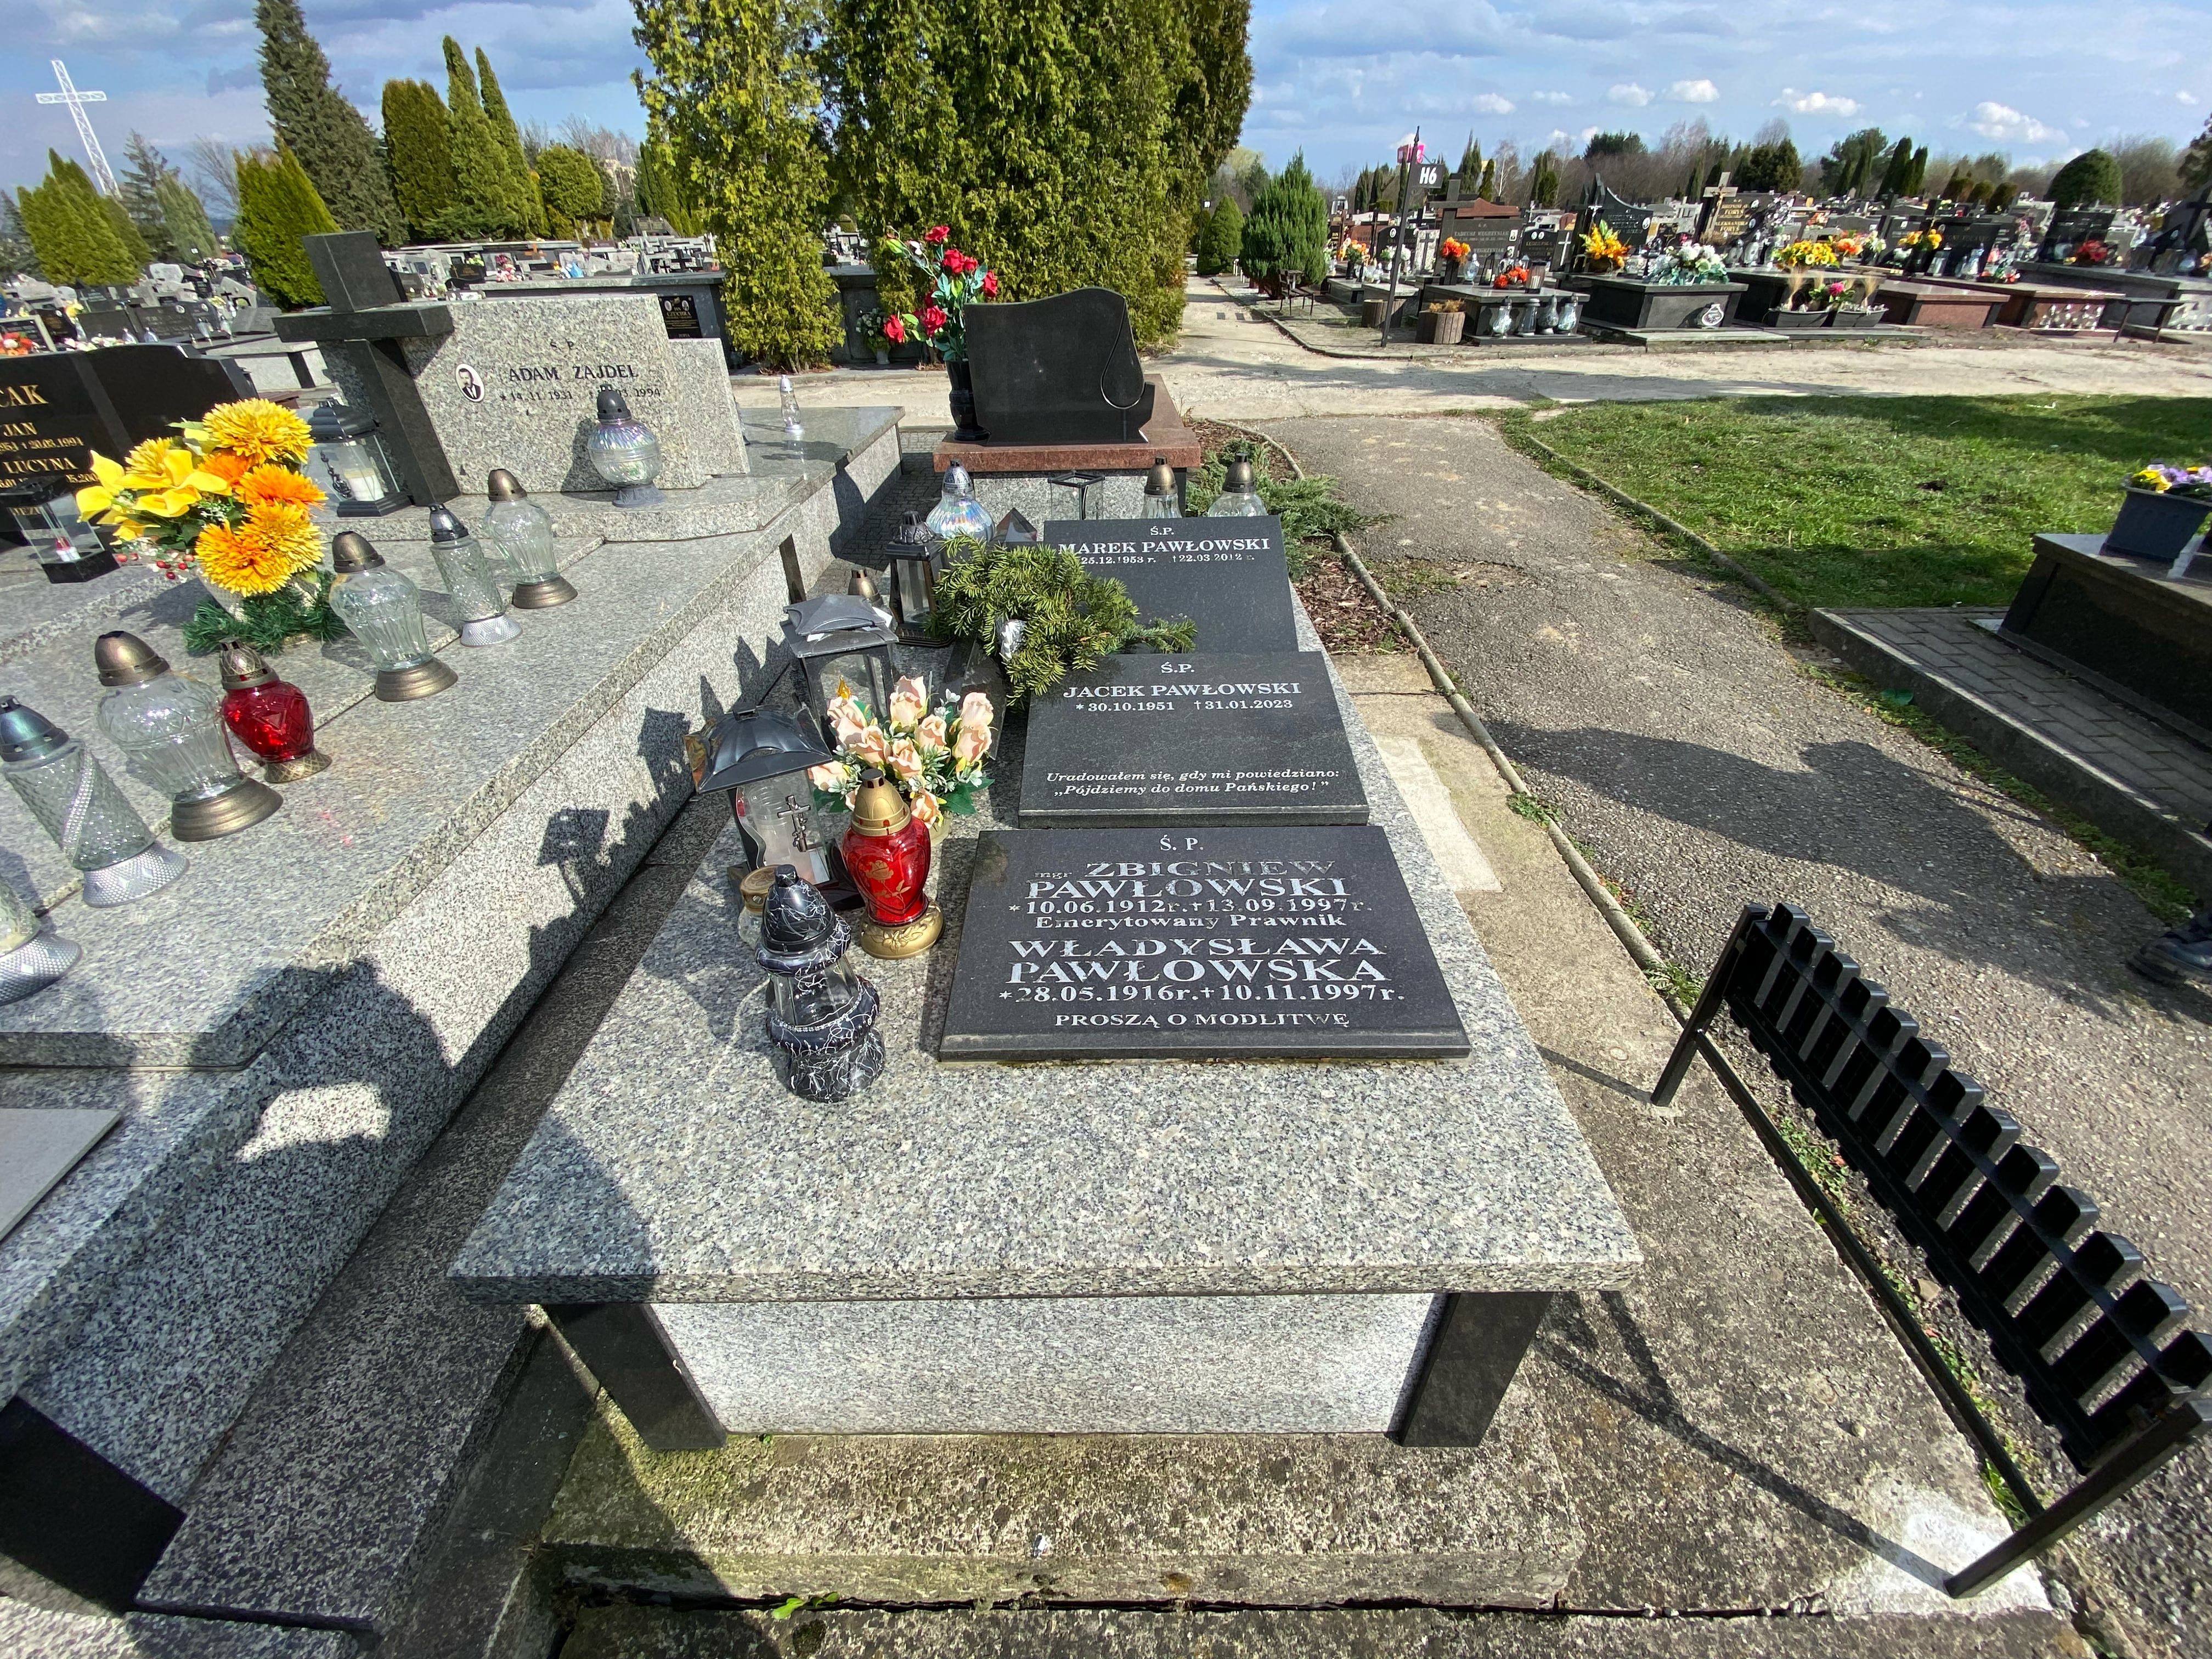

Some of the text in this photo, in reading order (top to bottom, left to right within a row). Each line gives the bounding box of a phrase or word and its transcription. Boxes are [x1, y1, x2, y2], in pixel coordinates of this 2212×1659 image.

[1419, 166, 1437, 184] H6
[509, 364, 639, 381] ADAM ZAJDEL
[3, 422, 38, 437] JAN
[3, 457, 79, 474] LUCYNA
[1058, 538, 1271, 555] MAREK PAWŁOWSKI
[1160, 661, 1195, 674] Ś.P.
[1063, 682, 1302, 698] JACEK PAWŁOWSKI
[1088, 699, 1294, 712] 30.10.1951 31.01.2023
[1046, 769, 1340, 782] Uradowałem się, gdy mi powiedziano:
[1150, 783, 1171, 793] do
[1175, 783, 1221, 793] domu
[1084, 861, 1335, 878] ZBIGNIEW
[1024, 878, 1351, 899] PAWŁOWSKI
[1035, 913, 1347, 930] Emerytowany Prawnik
[1008, 938, 1387, 958] WŁADYSŁAWA
[1005, 959, 1392, 984] PAWŁOWSKA
[1055, 1013, 1350, 1029] PROSZĄ O MODLITWĘ
